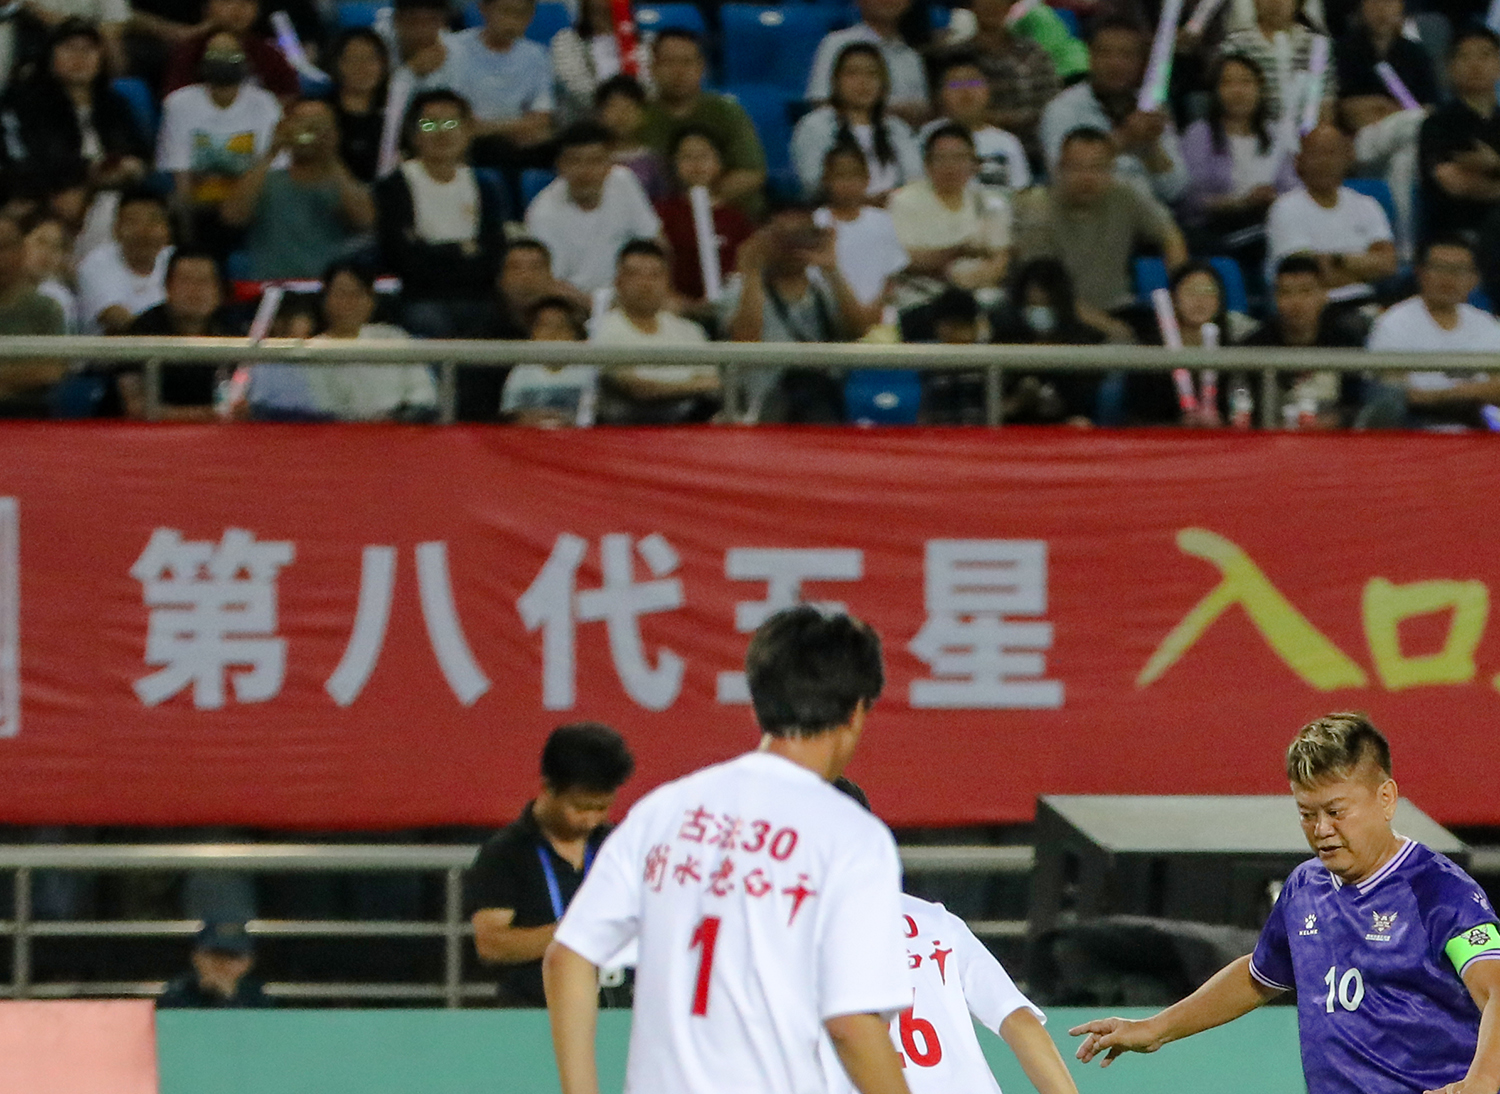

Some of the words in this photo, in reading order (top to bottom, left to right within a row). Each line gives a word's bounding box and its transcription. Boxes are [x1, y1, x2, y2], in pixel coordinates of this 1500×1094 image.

[690, 914, 721, 1017] 1
[1324, 966, 1365, 1013] 10
[888, 985, 942, 1069] 6
